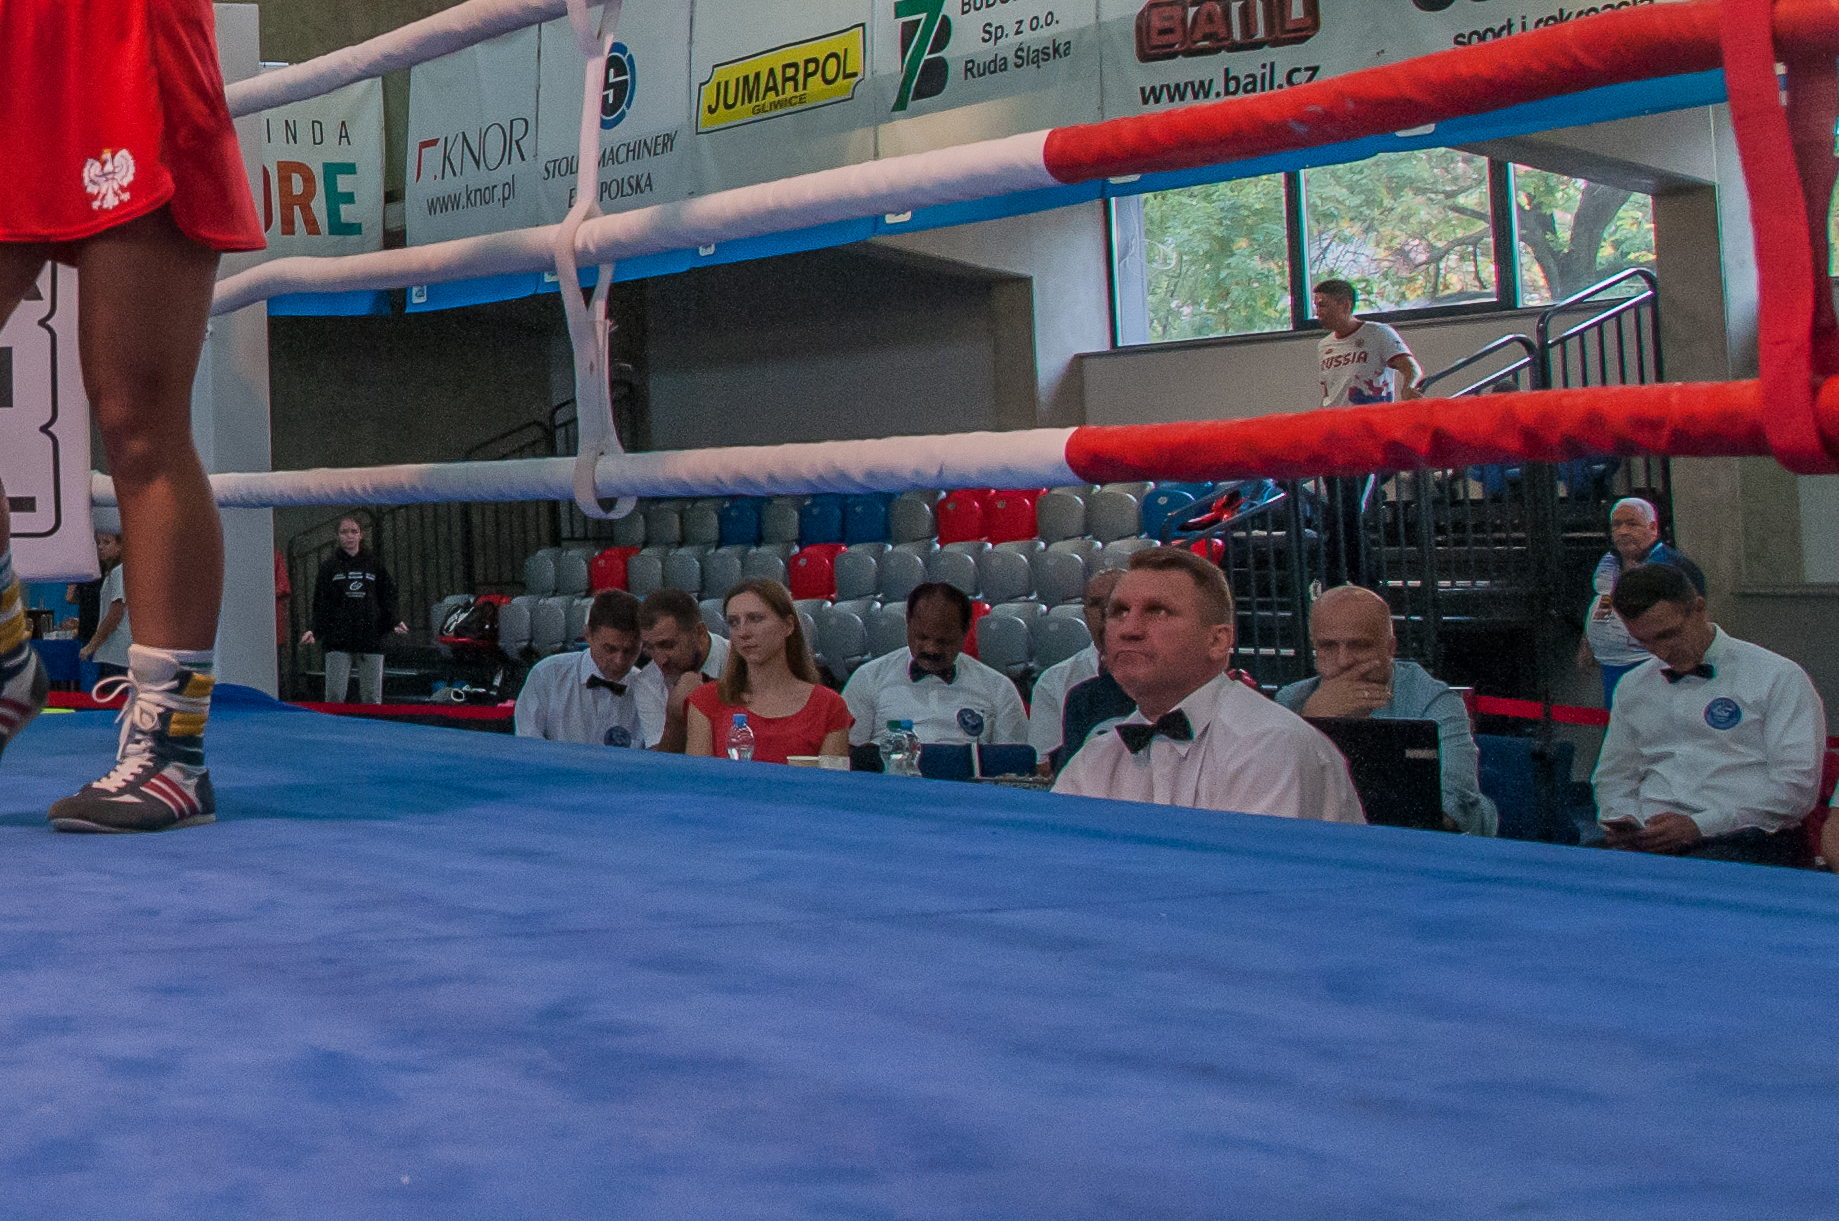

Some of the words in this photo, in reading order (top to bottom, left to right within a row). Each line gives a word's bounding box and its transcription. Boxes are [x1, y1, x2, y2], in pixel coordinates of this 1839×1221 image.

[981, 22, 1009, 46] Sp.
[1014, 19, 1024, 36] z
[1029, 10, 1060, 32] o.o.
[963, 53, 1008, 80] Ruda
[1014, 39, 1071, 69] Śląska
[707, 48, 859, 115] JUMARPOL
[1139, 61, 1321, 106] www.bail.cz
[426, 174, 516, 216] www.knor.pl
[599, 172, 653, 202] POLSKA
